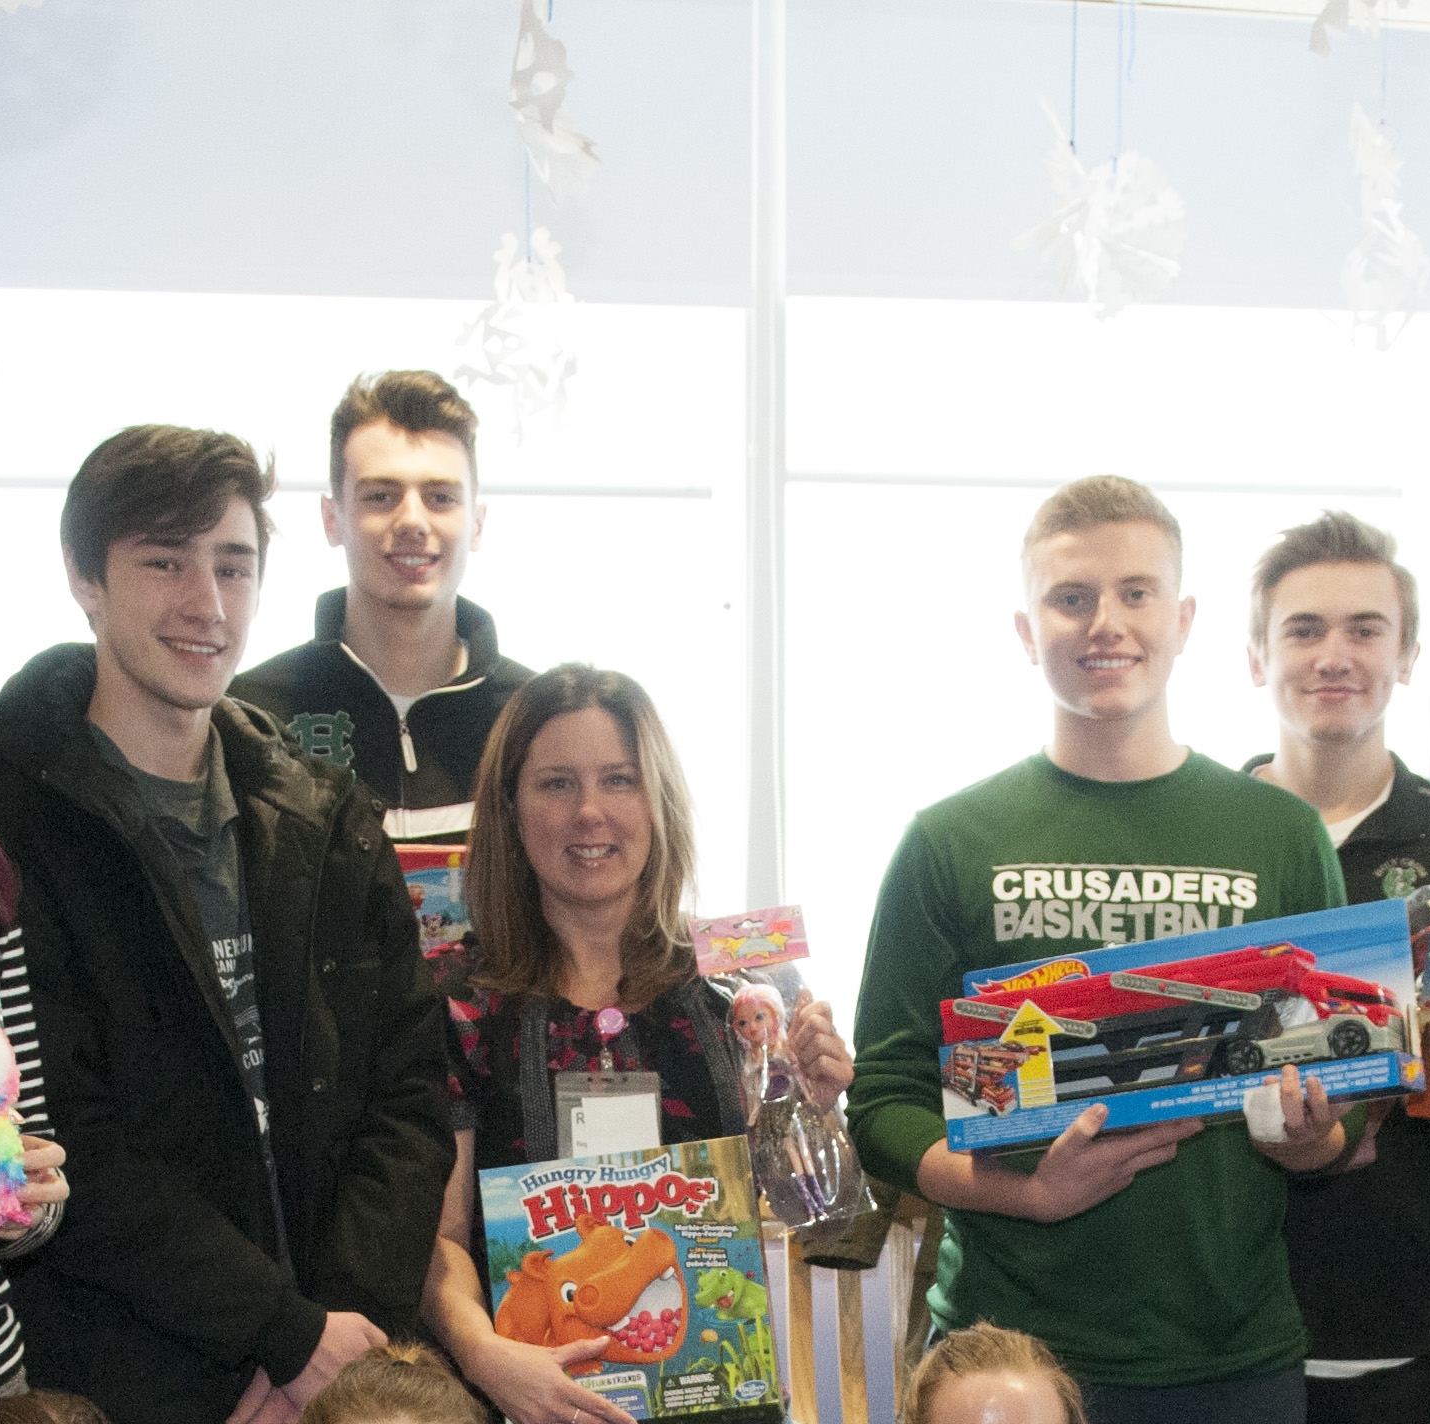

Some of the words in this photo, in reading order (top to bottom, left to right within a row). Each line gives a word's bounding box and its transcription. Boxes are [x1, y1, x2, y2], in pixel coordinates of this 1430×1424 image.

[992, 869, 1258, 909] CRUSADERS
[521, 1167, 597, 1194] Hungry
[599, 1156, 669, 1183] Hungry
